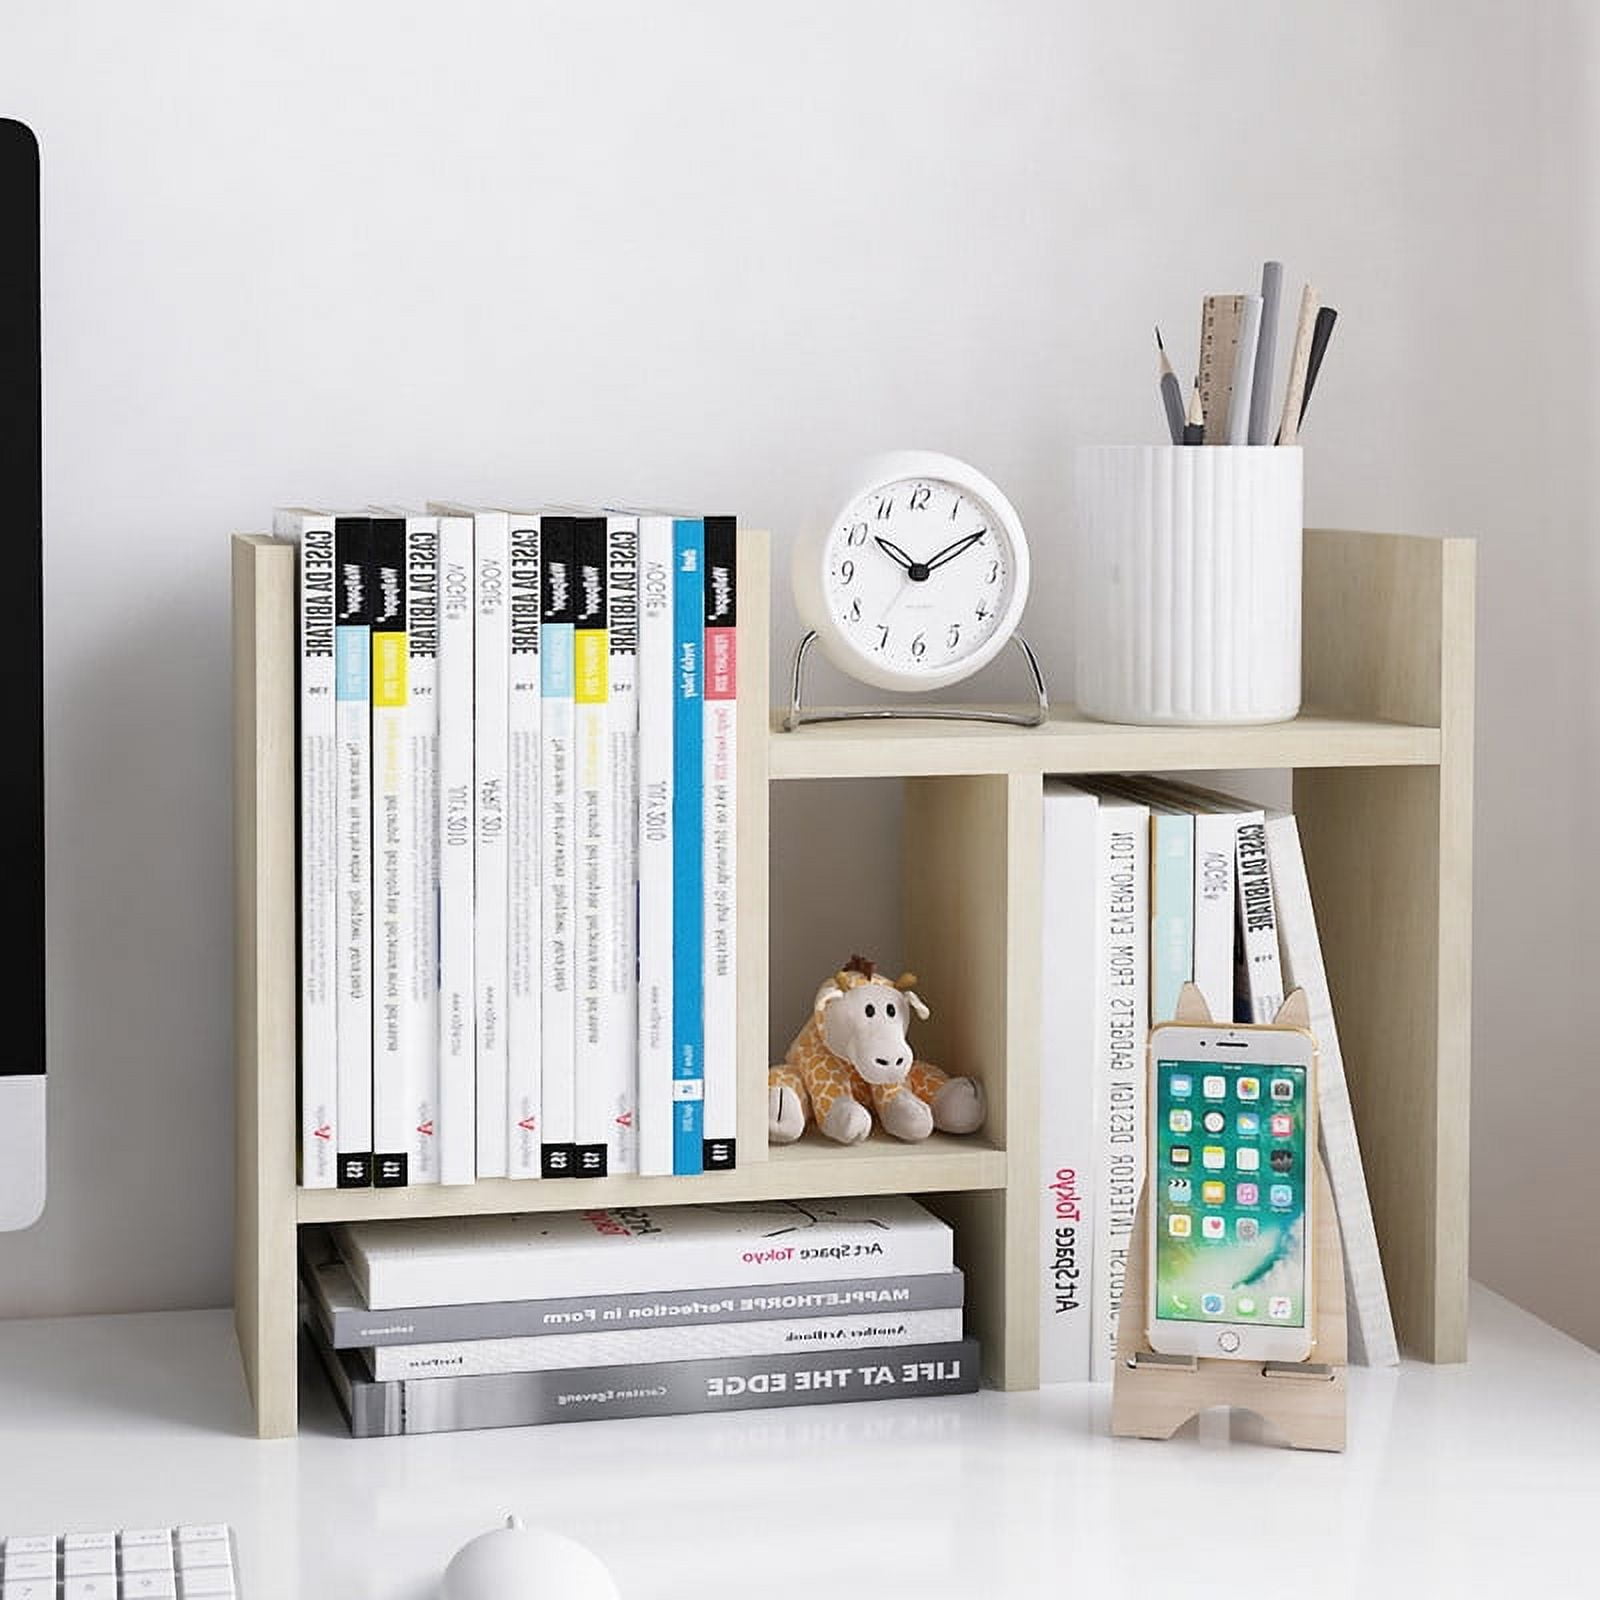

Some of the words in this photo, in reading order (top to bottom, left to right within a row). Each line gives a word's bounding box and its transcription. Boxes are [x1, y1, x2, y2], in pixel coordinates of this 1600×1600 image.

[877, 498, 893, 520] 11
[910, 488, 931, 510] 12
[847, 523, 868, 546] 10
[841, 560, 854, 585] 9
[876, 624, 889, 649] 7
[912, 632, 926, 656] 6
[947, 623, 961, 648] 5
